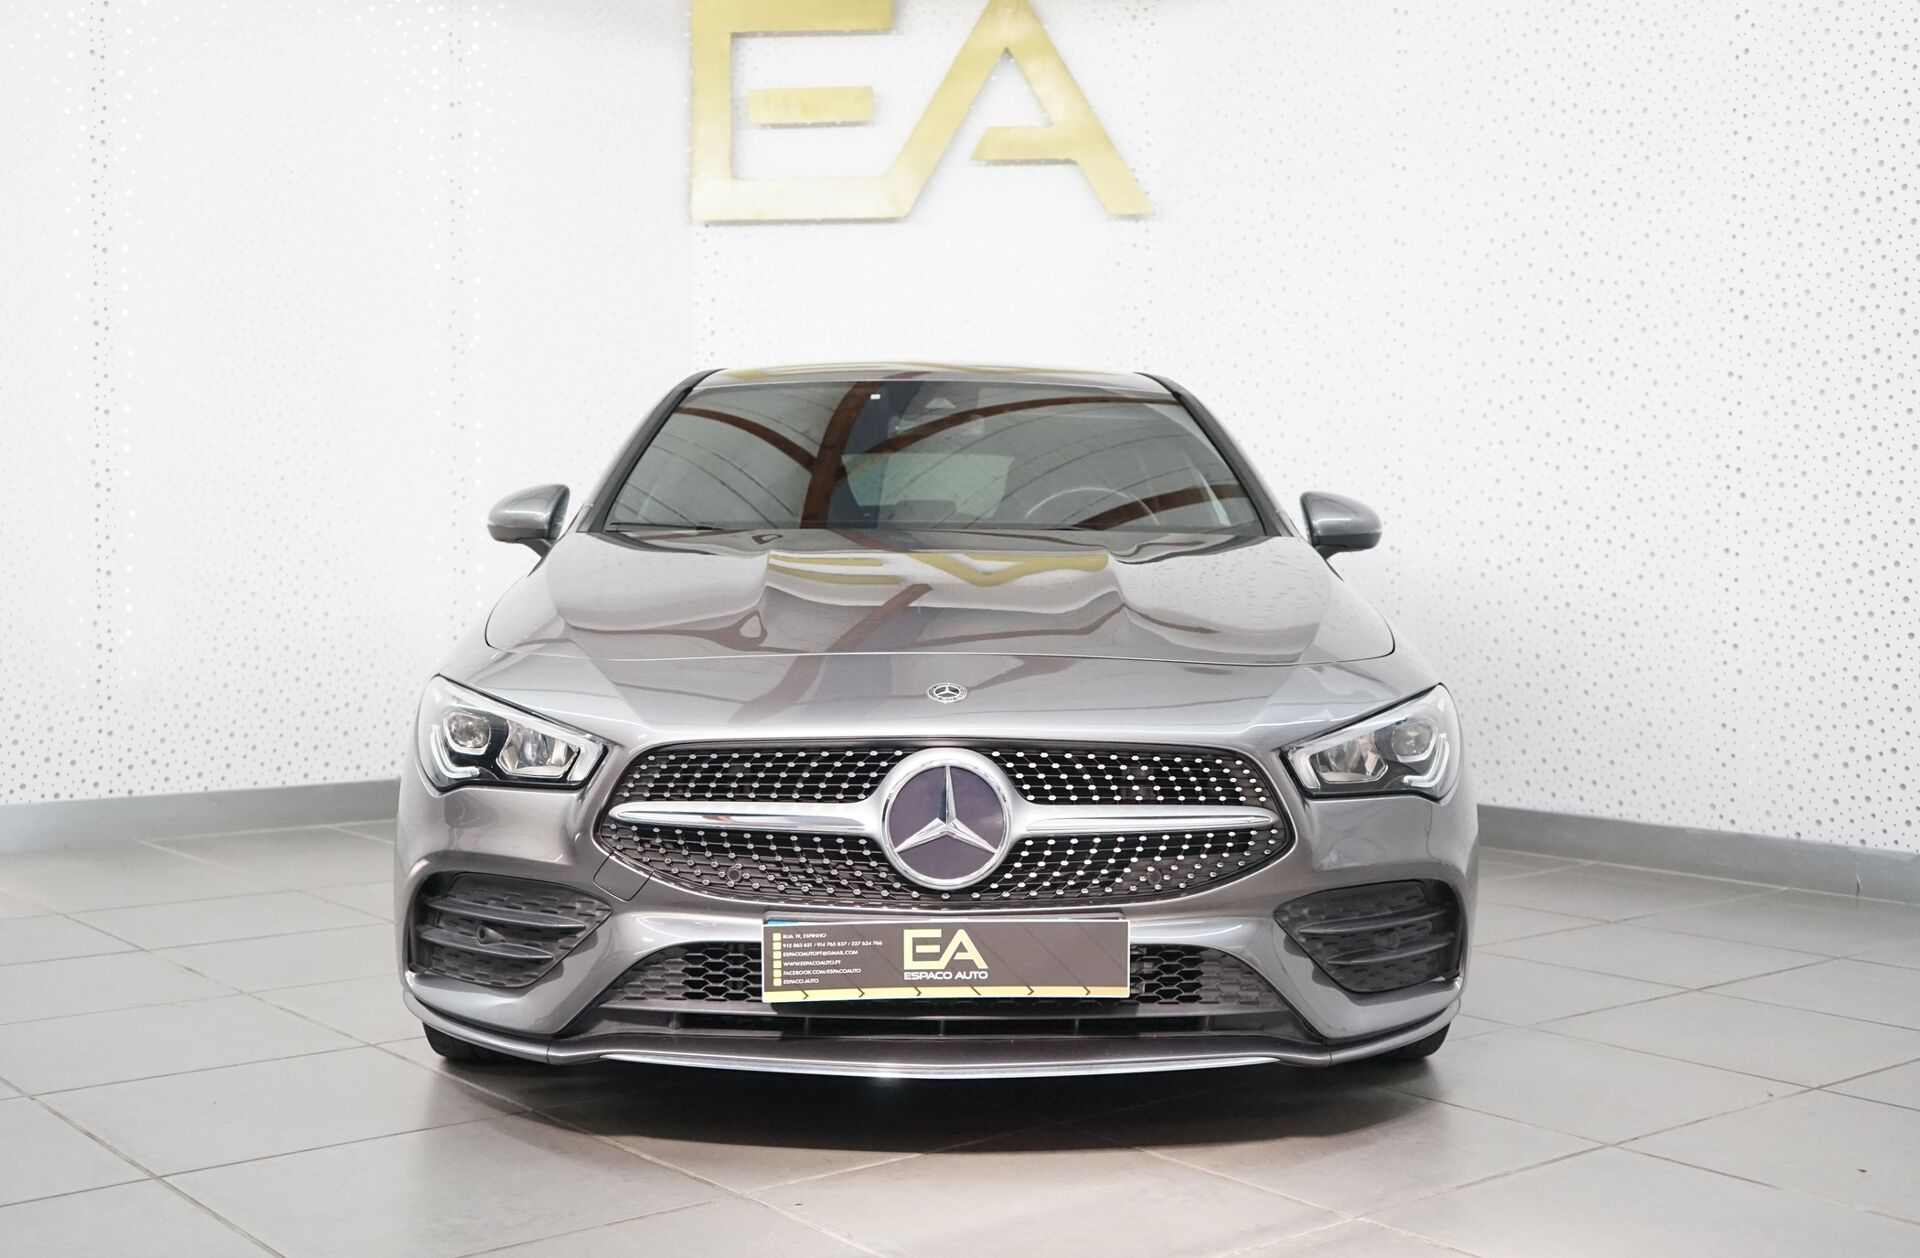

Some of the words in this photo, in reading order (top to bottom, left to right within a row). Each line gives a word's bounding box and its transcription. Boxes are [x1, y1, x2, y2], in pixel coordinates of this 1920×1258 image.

[691, 0, 1154, 222] EA
[903, 928, 989, 970] EA
[783, 959, 841, 967] WWW.ESPACOAUTO.PT
[903, 971, 952, 981] ESPACO
[954, 971, 989, 980] AUTO
